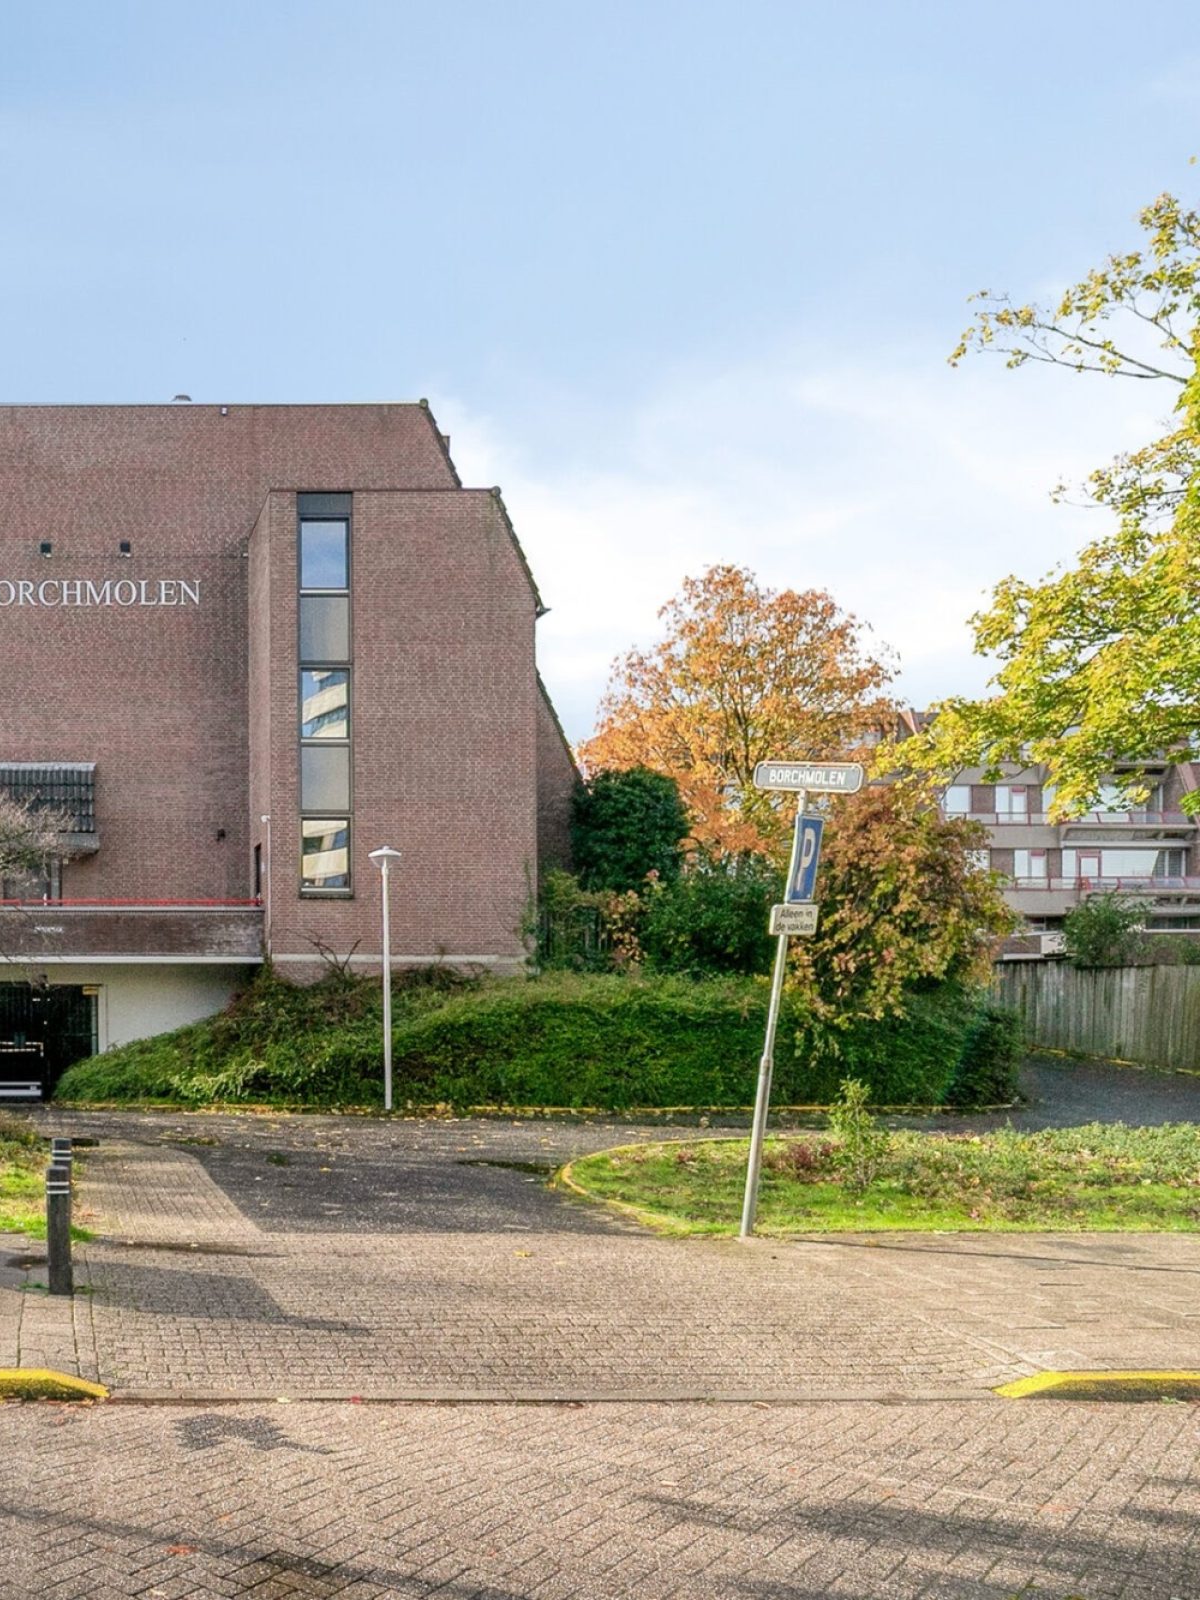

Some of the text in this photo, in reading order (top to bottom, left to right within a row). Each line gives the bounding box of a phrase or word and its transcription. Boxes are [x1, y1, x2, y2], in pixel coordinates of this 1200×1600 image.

[769, 768, 846, 786] BORCHMOLEN
[795, 827, 816, 891] P
[780, 908, 813, 918] Alleen in
[775, 921, 786, 931] de
